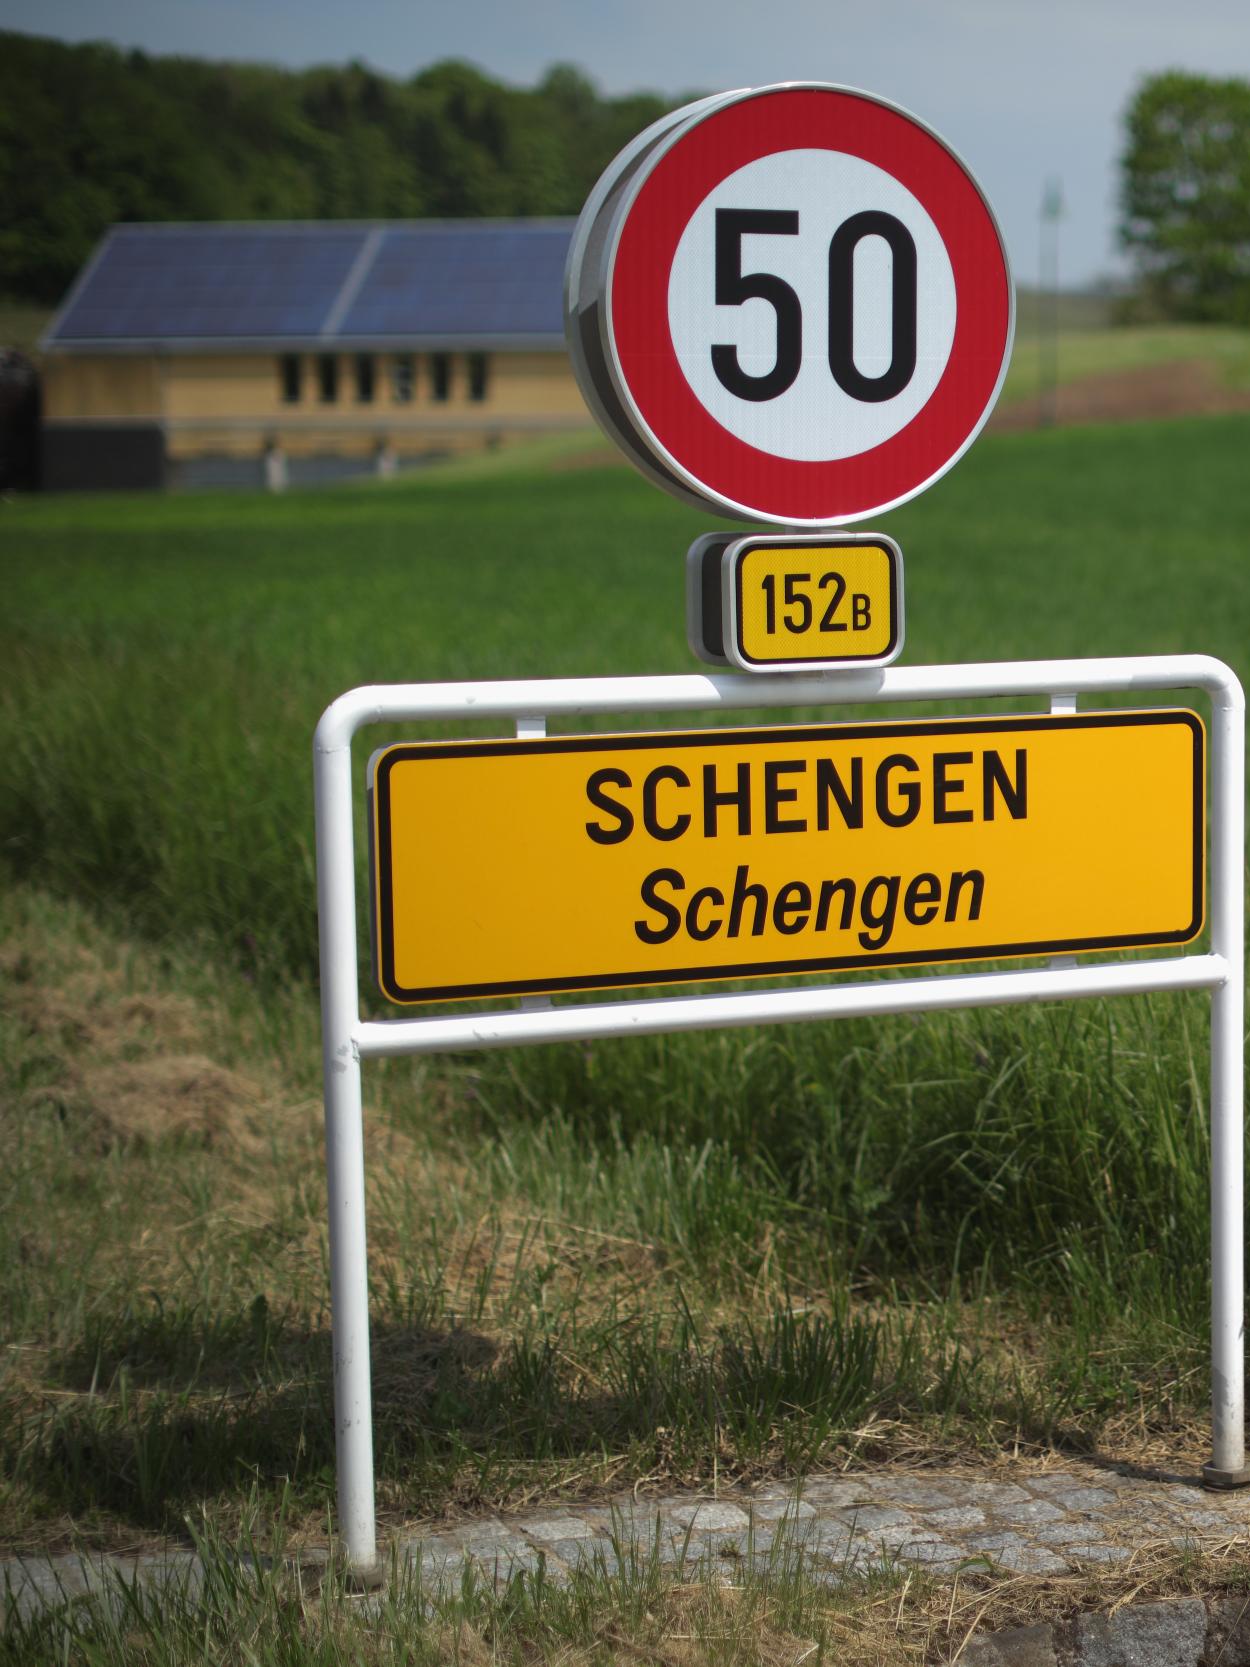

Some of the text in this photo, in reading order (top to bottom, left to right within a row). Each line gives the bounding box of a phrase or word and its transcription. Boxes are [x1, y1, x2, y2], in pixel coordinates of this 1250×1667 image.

[710, 207, 918, 403] 50
[761, 571, 872, 635] 152B
[585, 749, 1028, 845] SCHENGEN
[634, 865, 985, 951] Schengen
